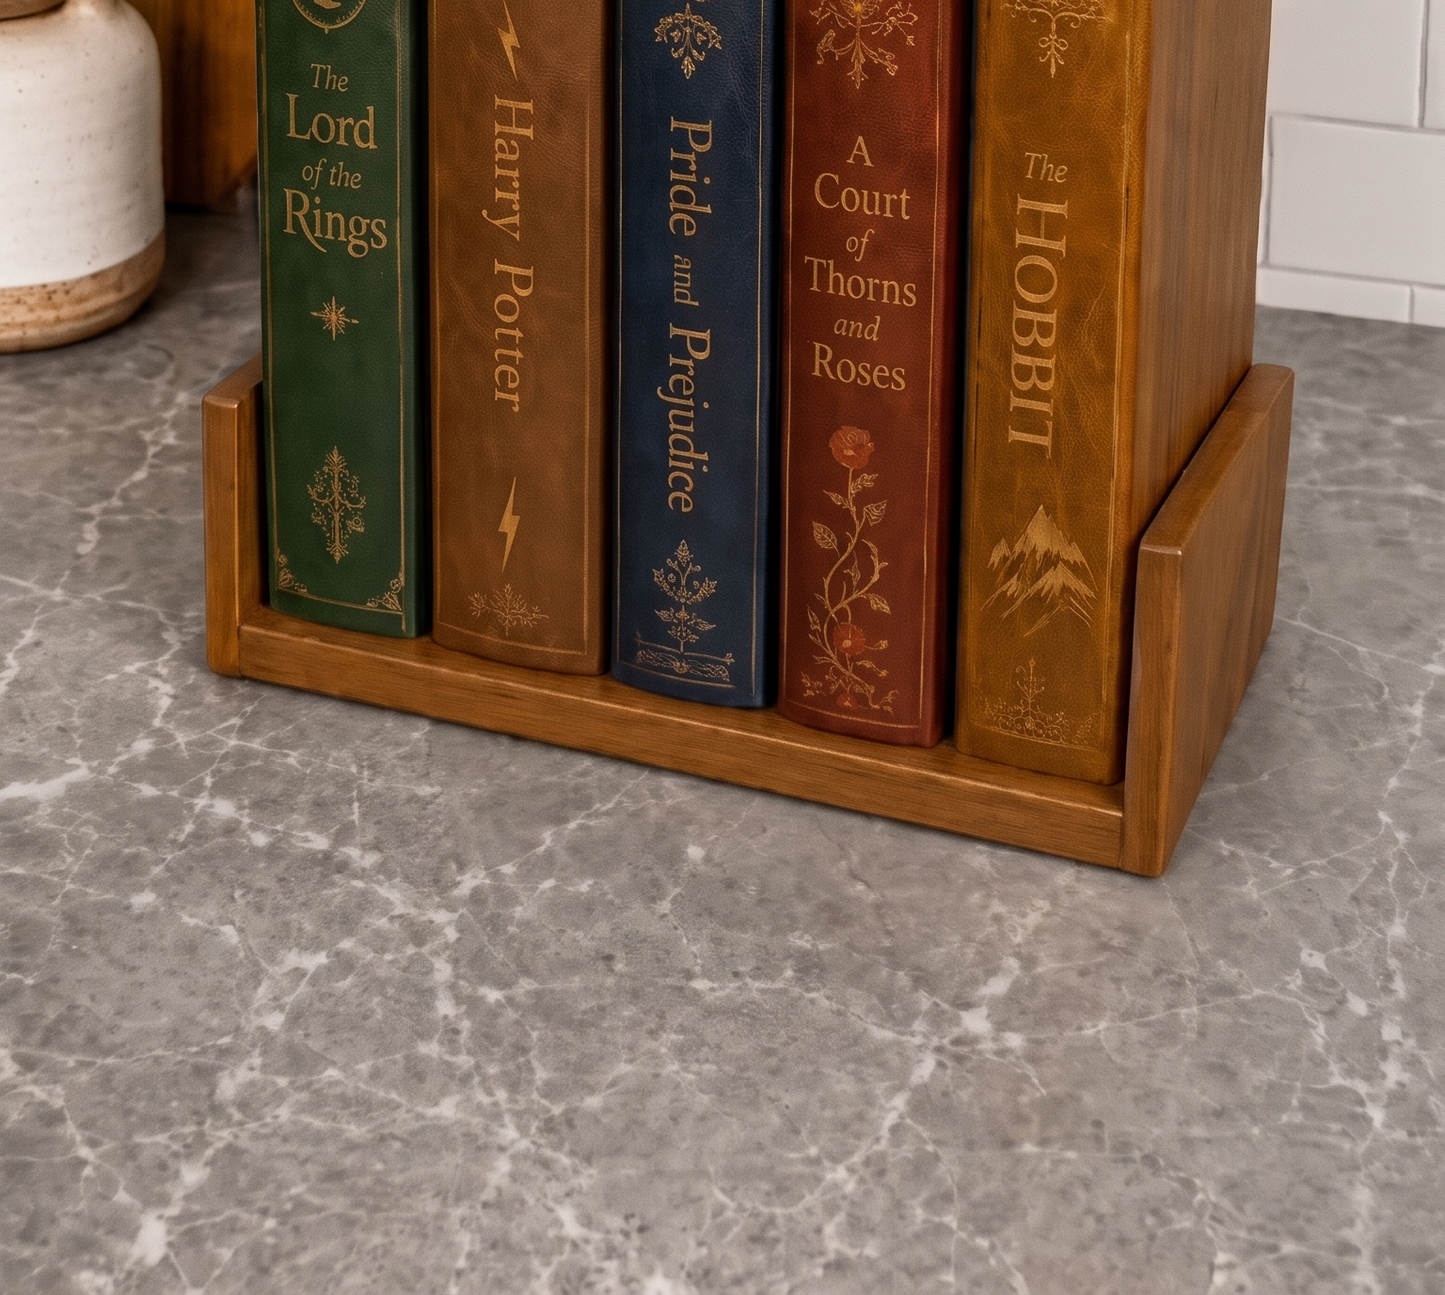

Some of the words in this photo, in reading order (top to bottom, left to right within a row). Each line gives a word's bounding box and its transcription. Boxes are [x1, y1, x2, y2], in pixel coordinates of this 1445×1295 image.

[310, 63, 349, 92] The
[285, 93, 378, 150] Lord
[302, 158, 327, 190] of
[329, 162, 362, 189] the
[482, 94, 534, 241] Harry
[669, 116, 713, 237] Pride
[846, 135, 874, 167] A
[1024, 152, 1068, 183] The
[814, 172, 911, 220] Court
[283, 188, 388, 258] Rings
[845, 228, 875, 262] of
[674, 254, 699, 307] and
[804, 255, 917, 307] Thorns
[494, 258, 534, 413] Potter
[833, 315, 881, 342] and
[1007, 193, 1069, 459] HOBBIT
[811, 341, 906, 391] Roses
[657, 322, 711, 514] Prejudice
